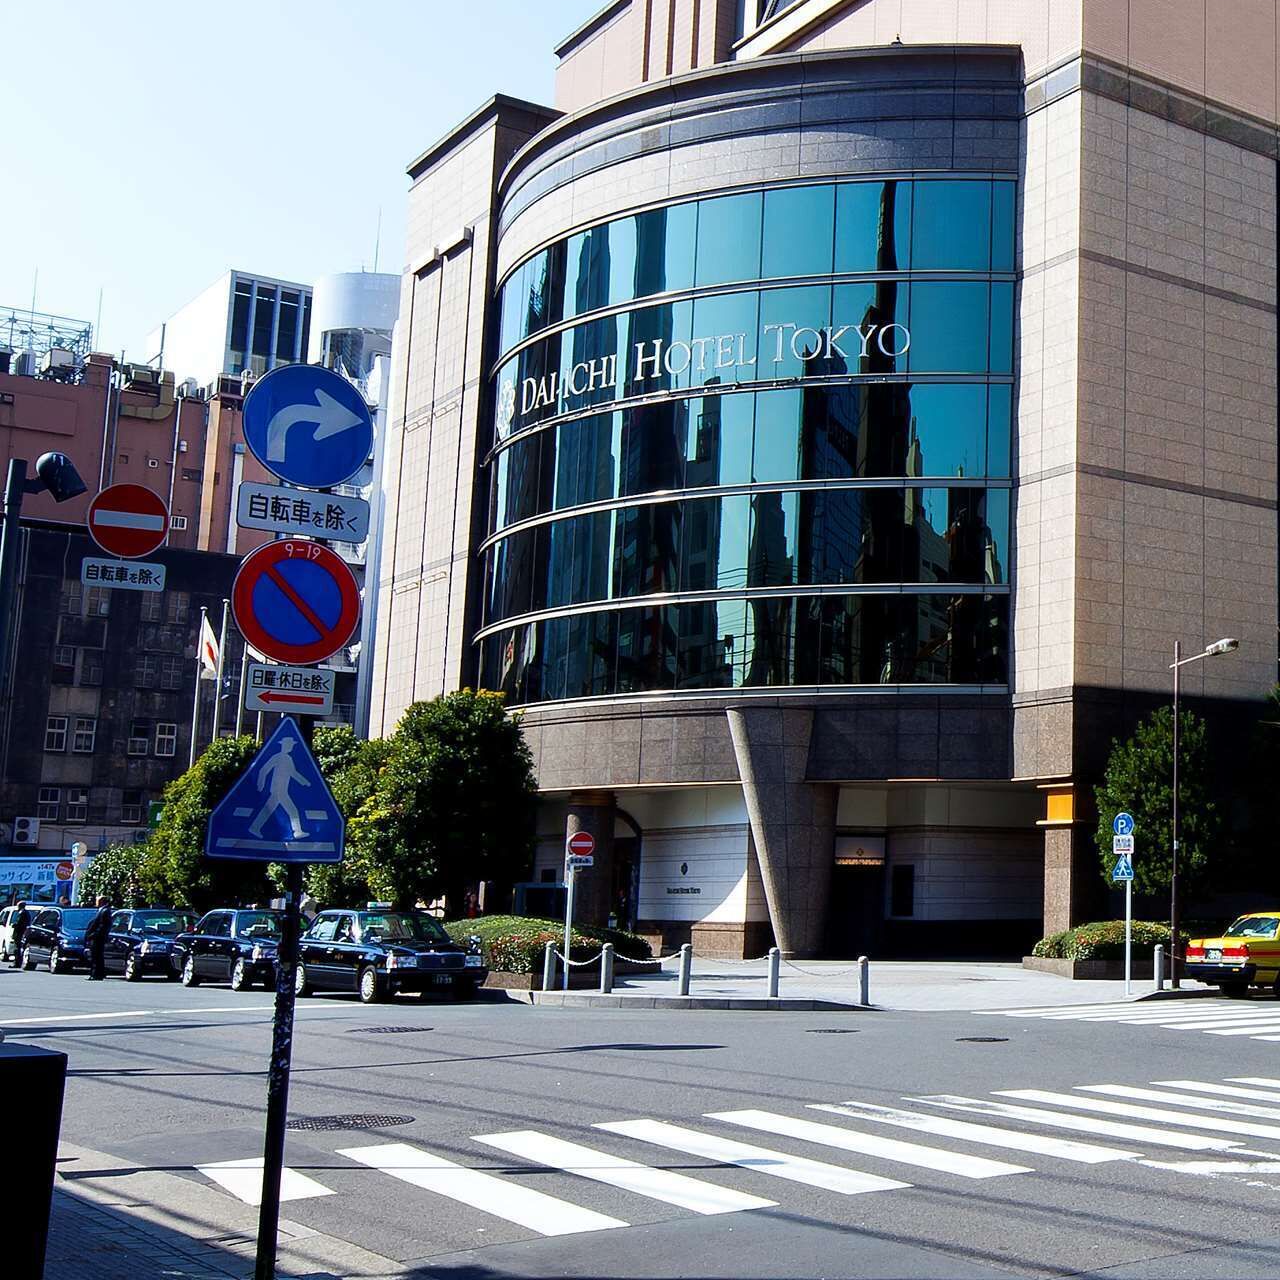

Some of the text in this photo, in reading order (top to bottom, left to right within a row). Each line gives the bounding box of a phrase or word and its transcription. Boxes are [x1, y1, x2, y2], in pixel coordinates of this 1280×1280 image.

[521, 322, 911, 415] DAI-ICHI HOTEL TOKYO
[248, 493, 358, 532] 自転車を除く
[285, 543, 321, 560] 9-19
[86, 564, 161, 585] 自転車を除く
